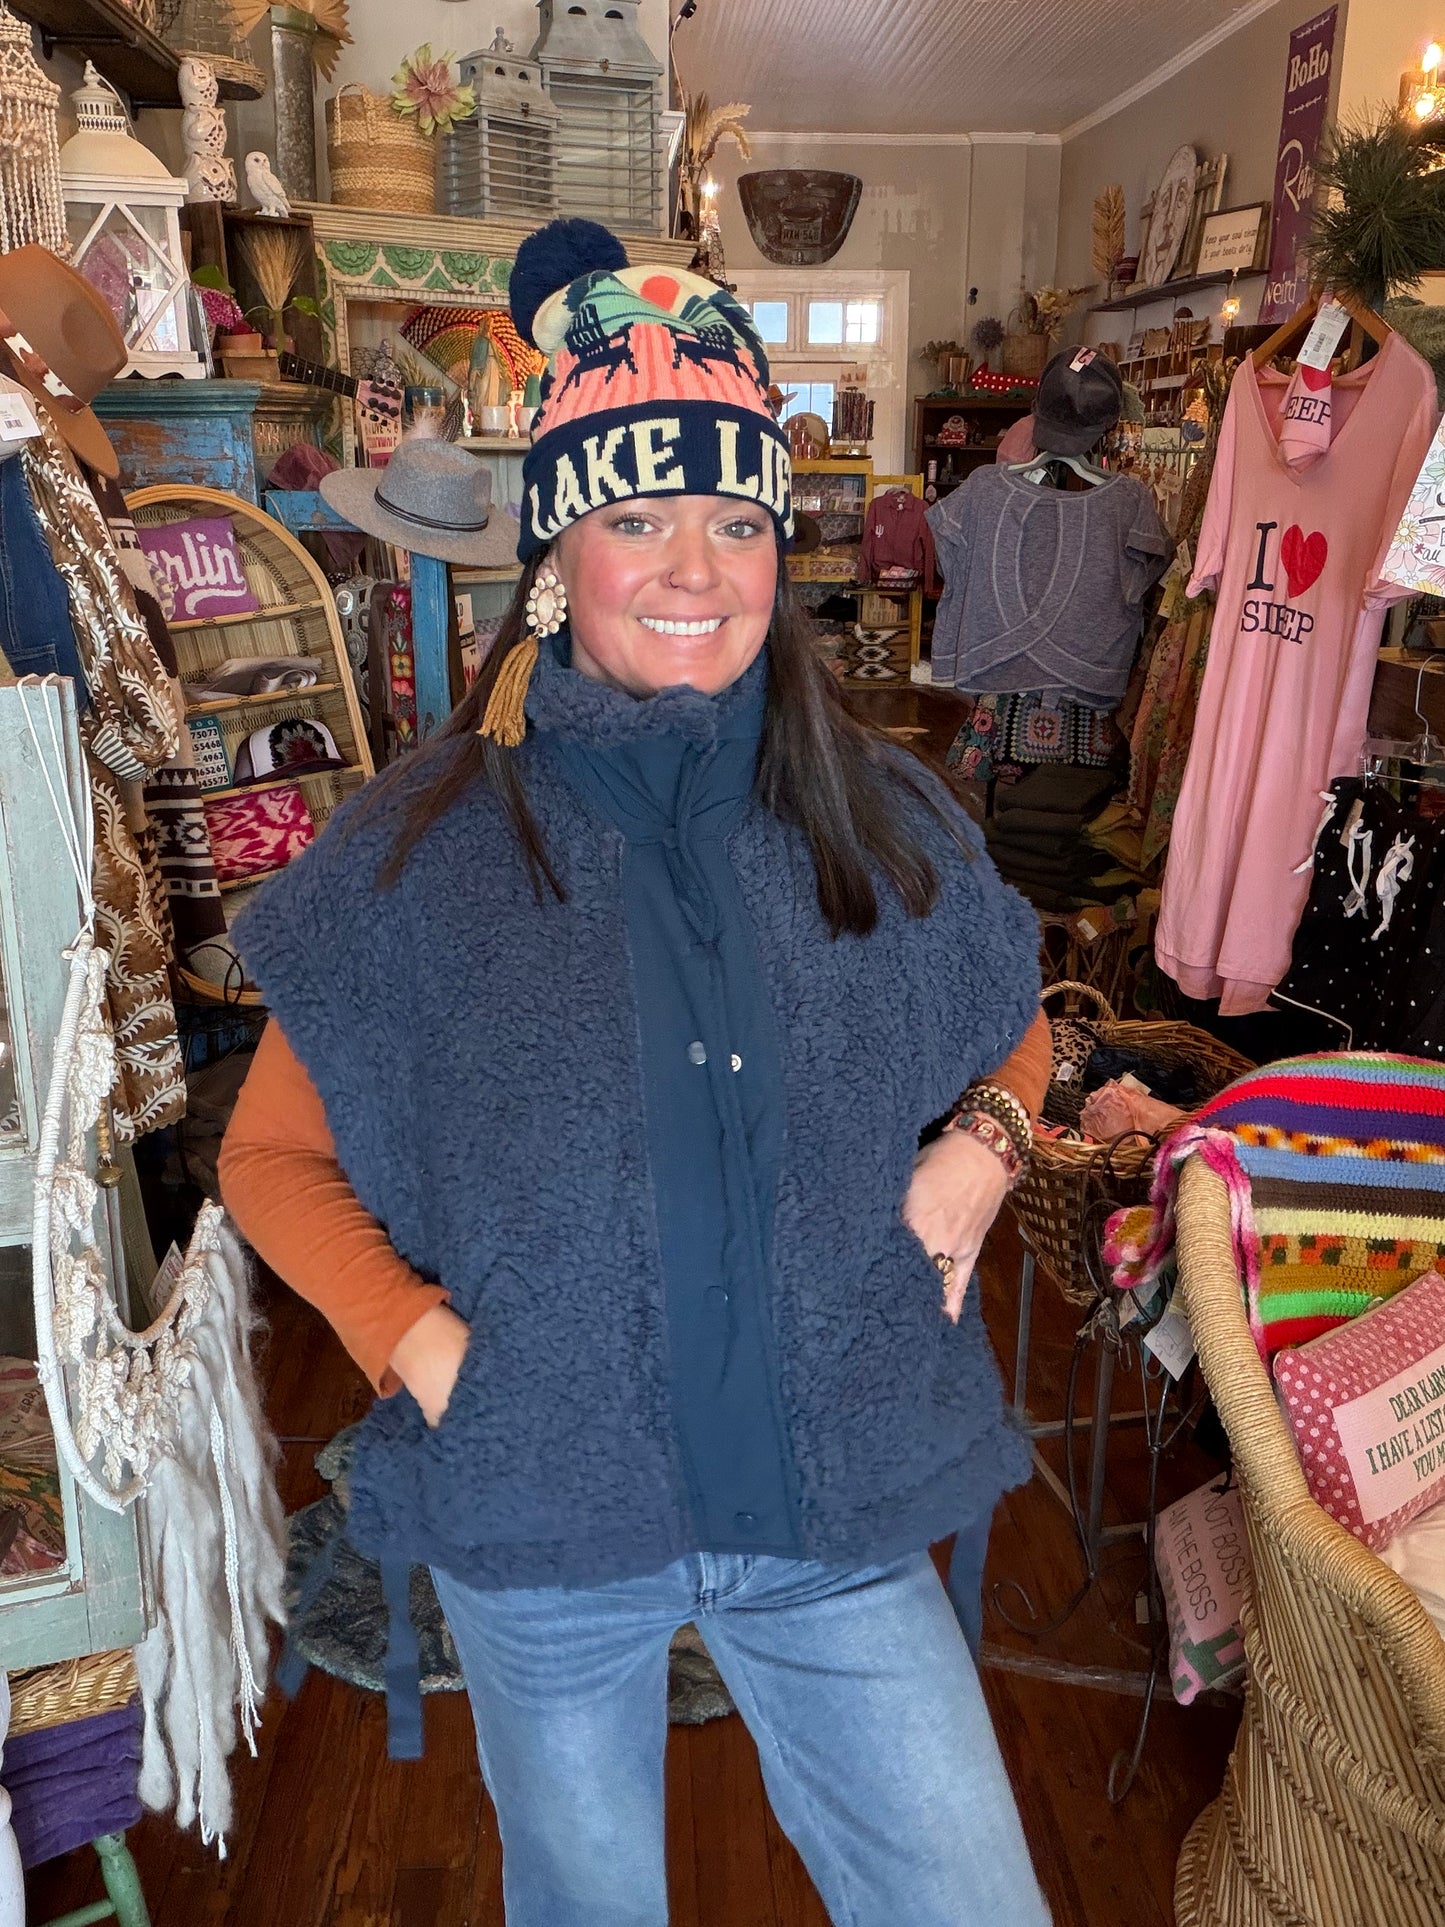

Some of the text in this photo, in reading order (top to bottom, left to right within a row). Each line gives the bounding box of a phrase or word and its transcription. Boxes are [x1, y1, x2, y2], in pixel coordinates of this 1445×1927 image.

[1288, 42, 1329, 93] BoHo
[529, 418, 795, 541] LAKE LIF
[1247, 521, 1278, 592] I
[192, 740, 222, 752] 55468
[1388, 1386, 1425, 1423] DEAR
[1365, 1447, 1379, 1476] I
[1376, 1429, 1414, 1471] HAVE
[1413, 1423, 1424, 1452] A
[1420, 1408, 1445, 1445] LIST
[1413, 1447, 1436, 1482] YOU
[1203, 1498, 1234, 1531] NOT
[1174, 1523, 1198, 1564] THE
[1181, 1558, 1218, 1622] BOSS
